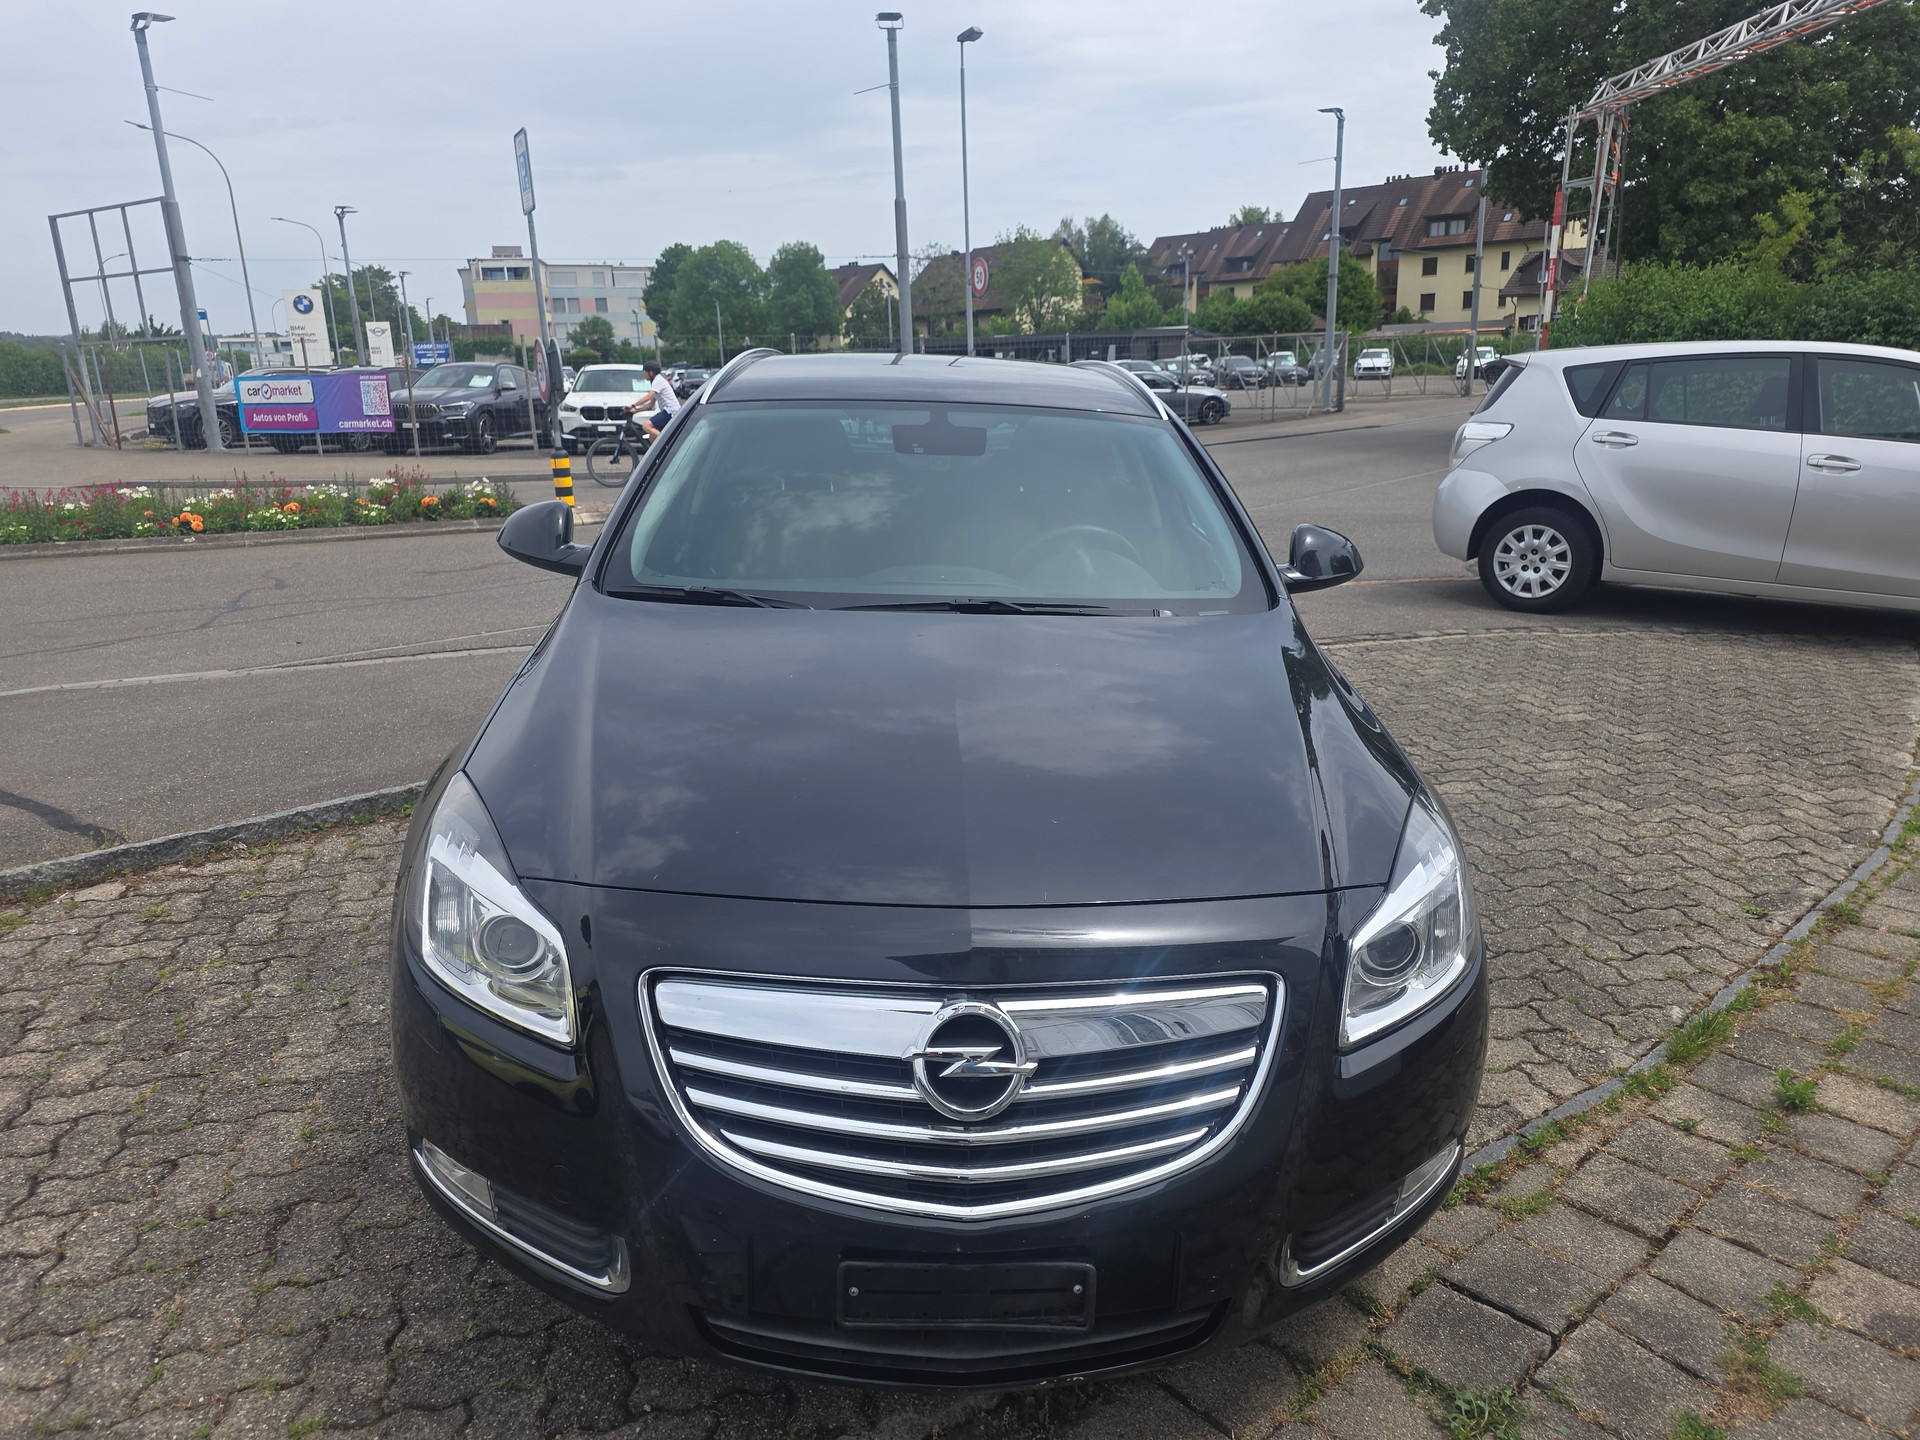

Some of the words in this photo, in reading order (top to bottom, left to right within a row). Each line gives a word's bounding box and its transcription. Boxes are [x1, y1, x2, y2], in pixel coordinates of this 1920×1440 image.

[253, 413, 272, 422] Autos
[273, 414, 287, 422] von
[287, 412, 308, 422] Profis
[339, 418, 393, 429] carmarket.ch
[937, 1005, 1003, 1022] OPEL
